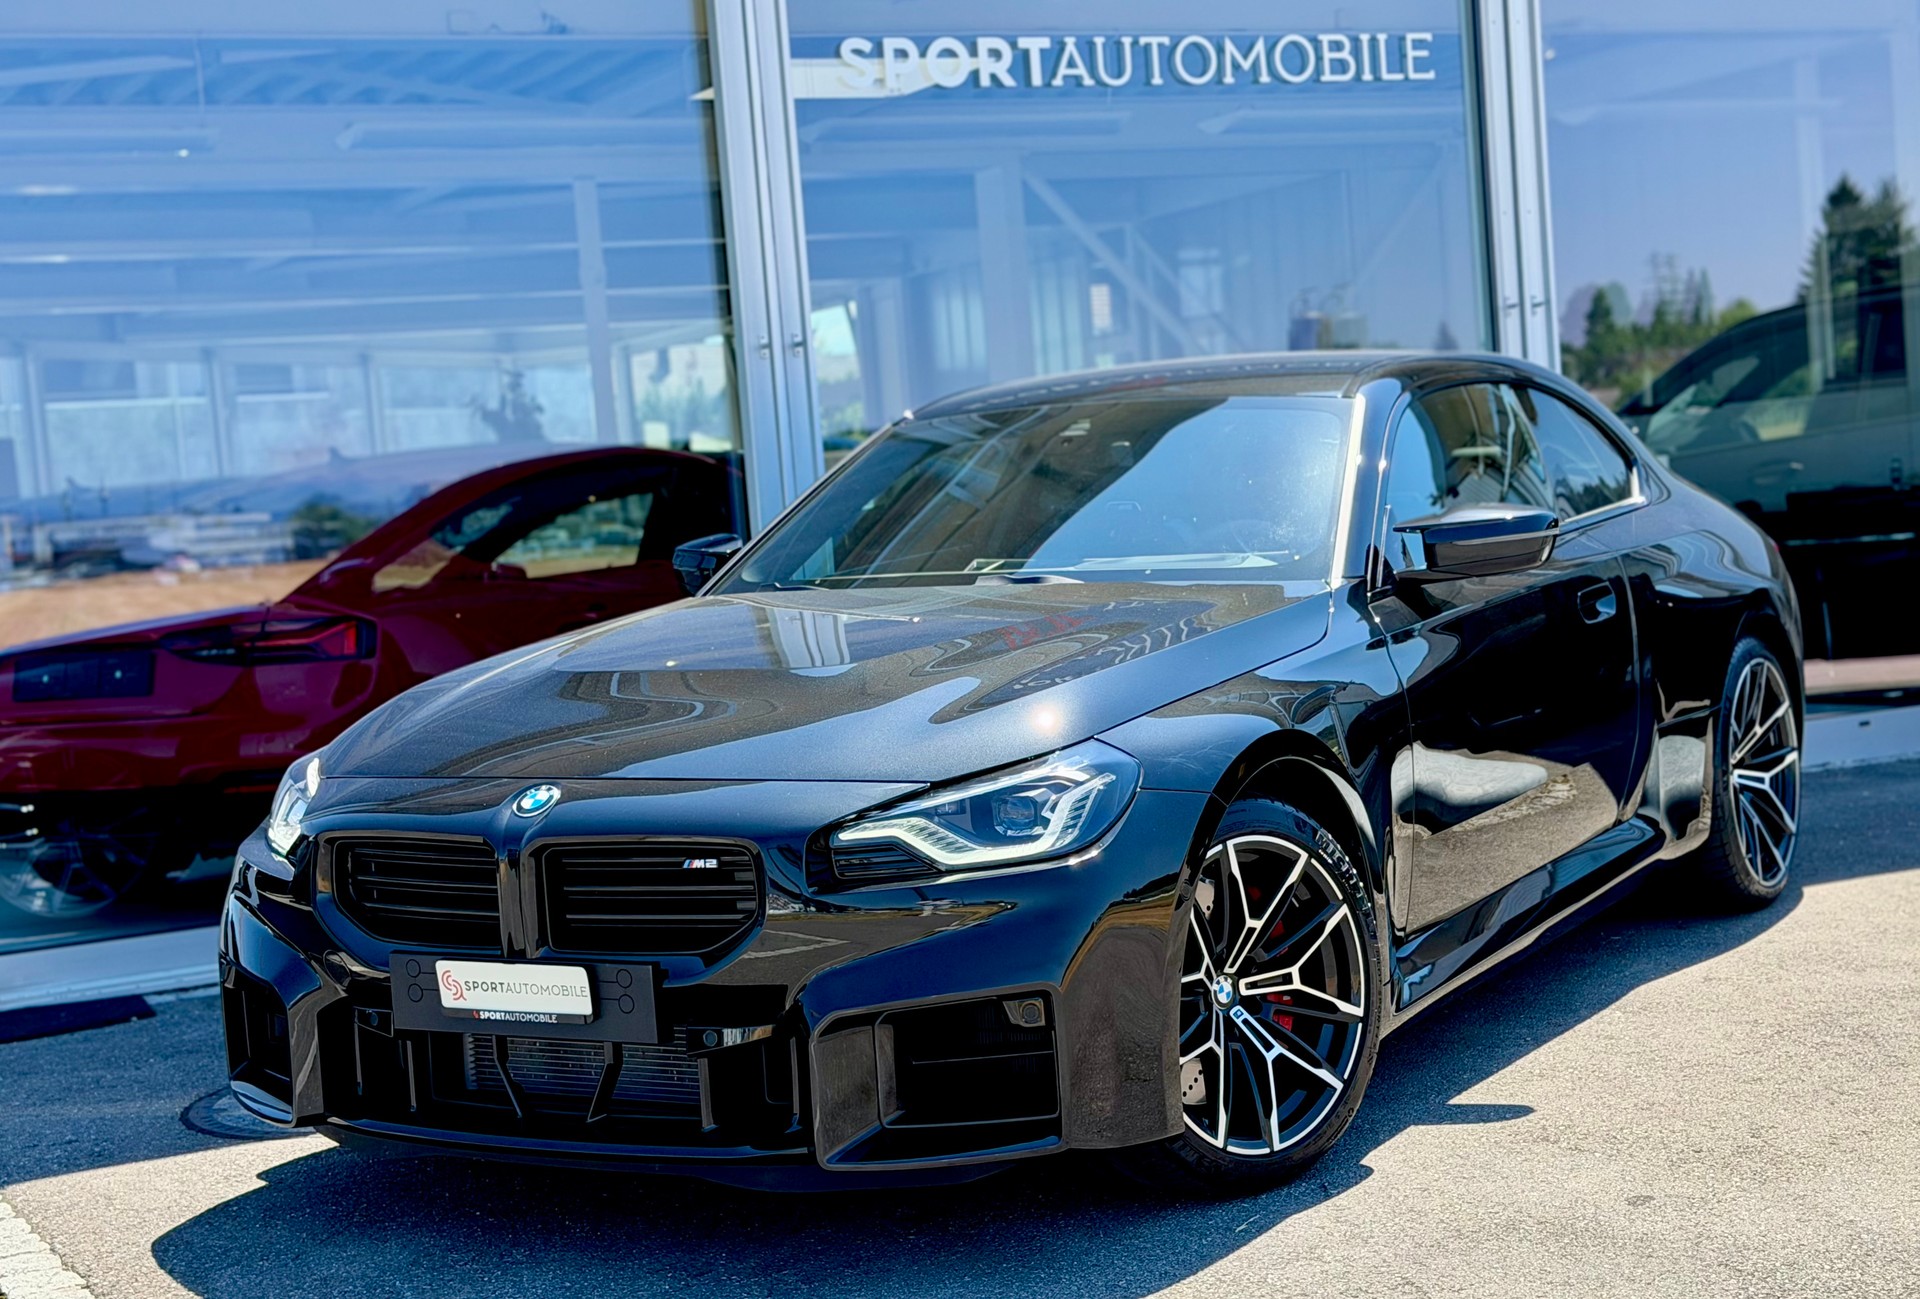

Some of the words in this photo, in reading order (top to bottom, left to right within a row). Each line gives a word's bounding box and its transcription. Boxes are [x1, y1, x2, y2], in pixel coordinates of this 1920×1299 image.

[839, 33, 1435, 88] SPORTAUTOMOBILE
[691, 858, 719, 869] M2
[464, 980, 588, 998] SPORTAUTOMOBILE
[480, 1010, 558, 1024] SPORTAUTOMOBILE
